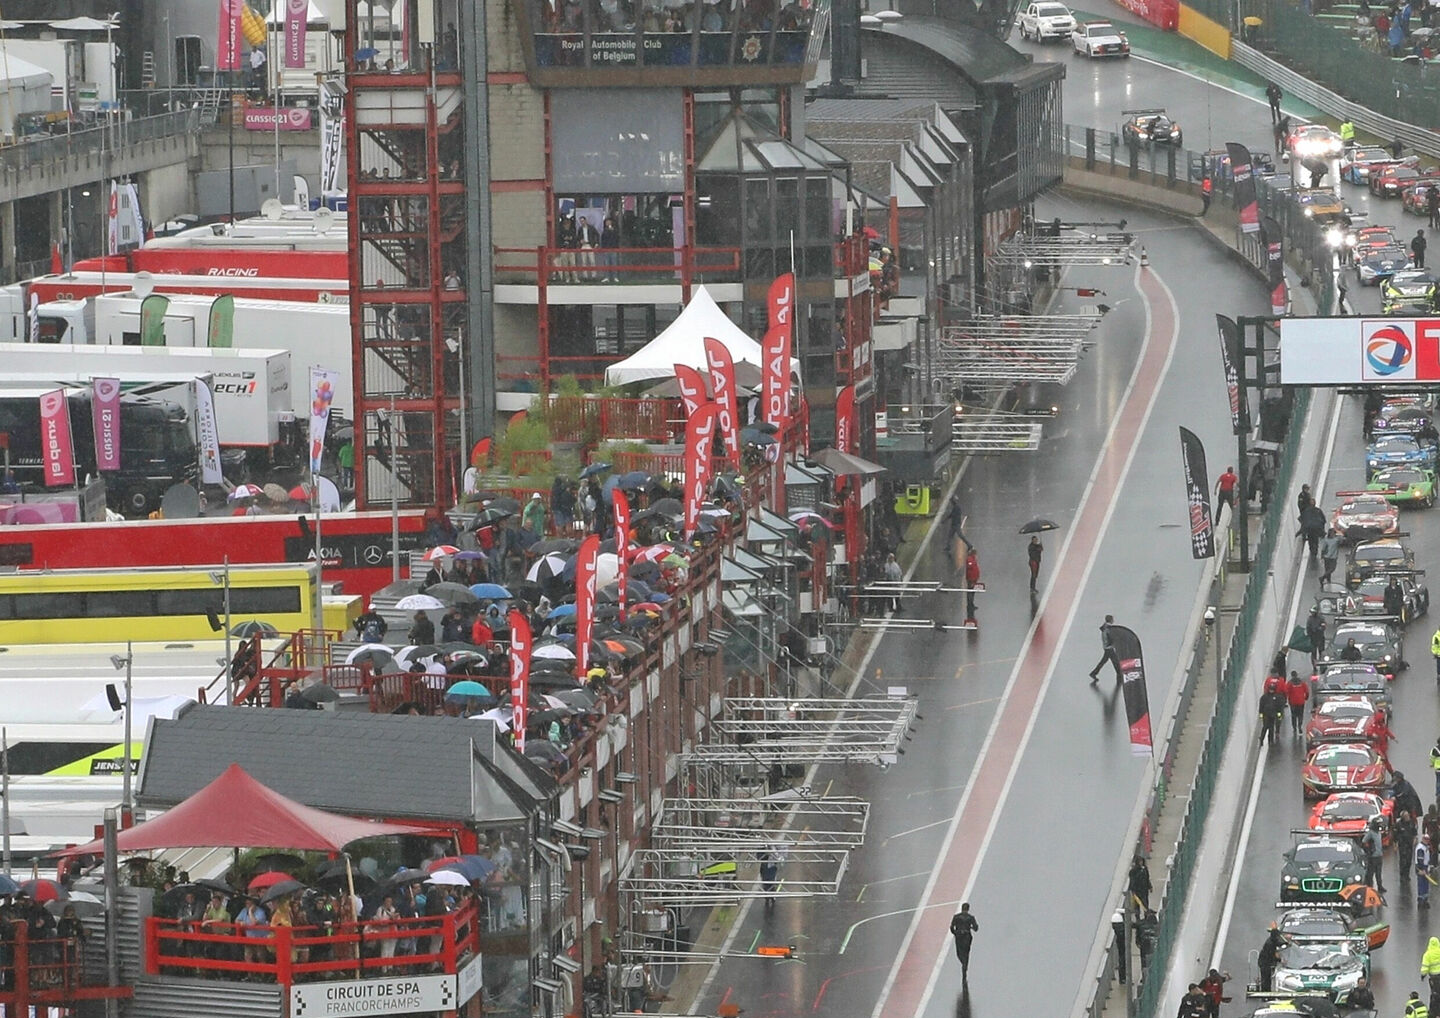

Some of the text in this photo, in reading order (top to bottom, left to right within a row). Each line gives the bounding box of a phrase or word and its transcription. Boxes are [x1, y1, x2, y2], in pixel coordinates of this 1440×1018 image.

[562, 40, 662, 51] Royal Automobile Club
[593, 51, 635, 62] of Belgium
[246, 114, 276, 123] CLASSIC
[208, 268, 259, 276] RACING
[94, 762, 137, 770] JENSN
[327, 982, 420, 1000] CIRCUIT DE SPA
[327, 997, 421, 1013] FRANCORCHAMPS
